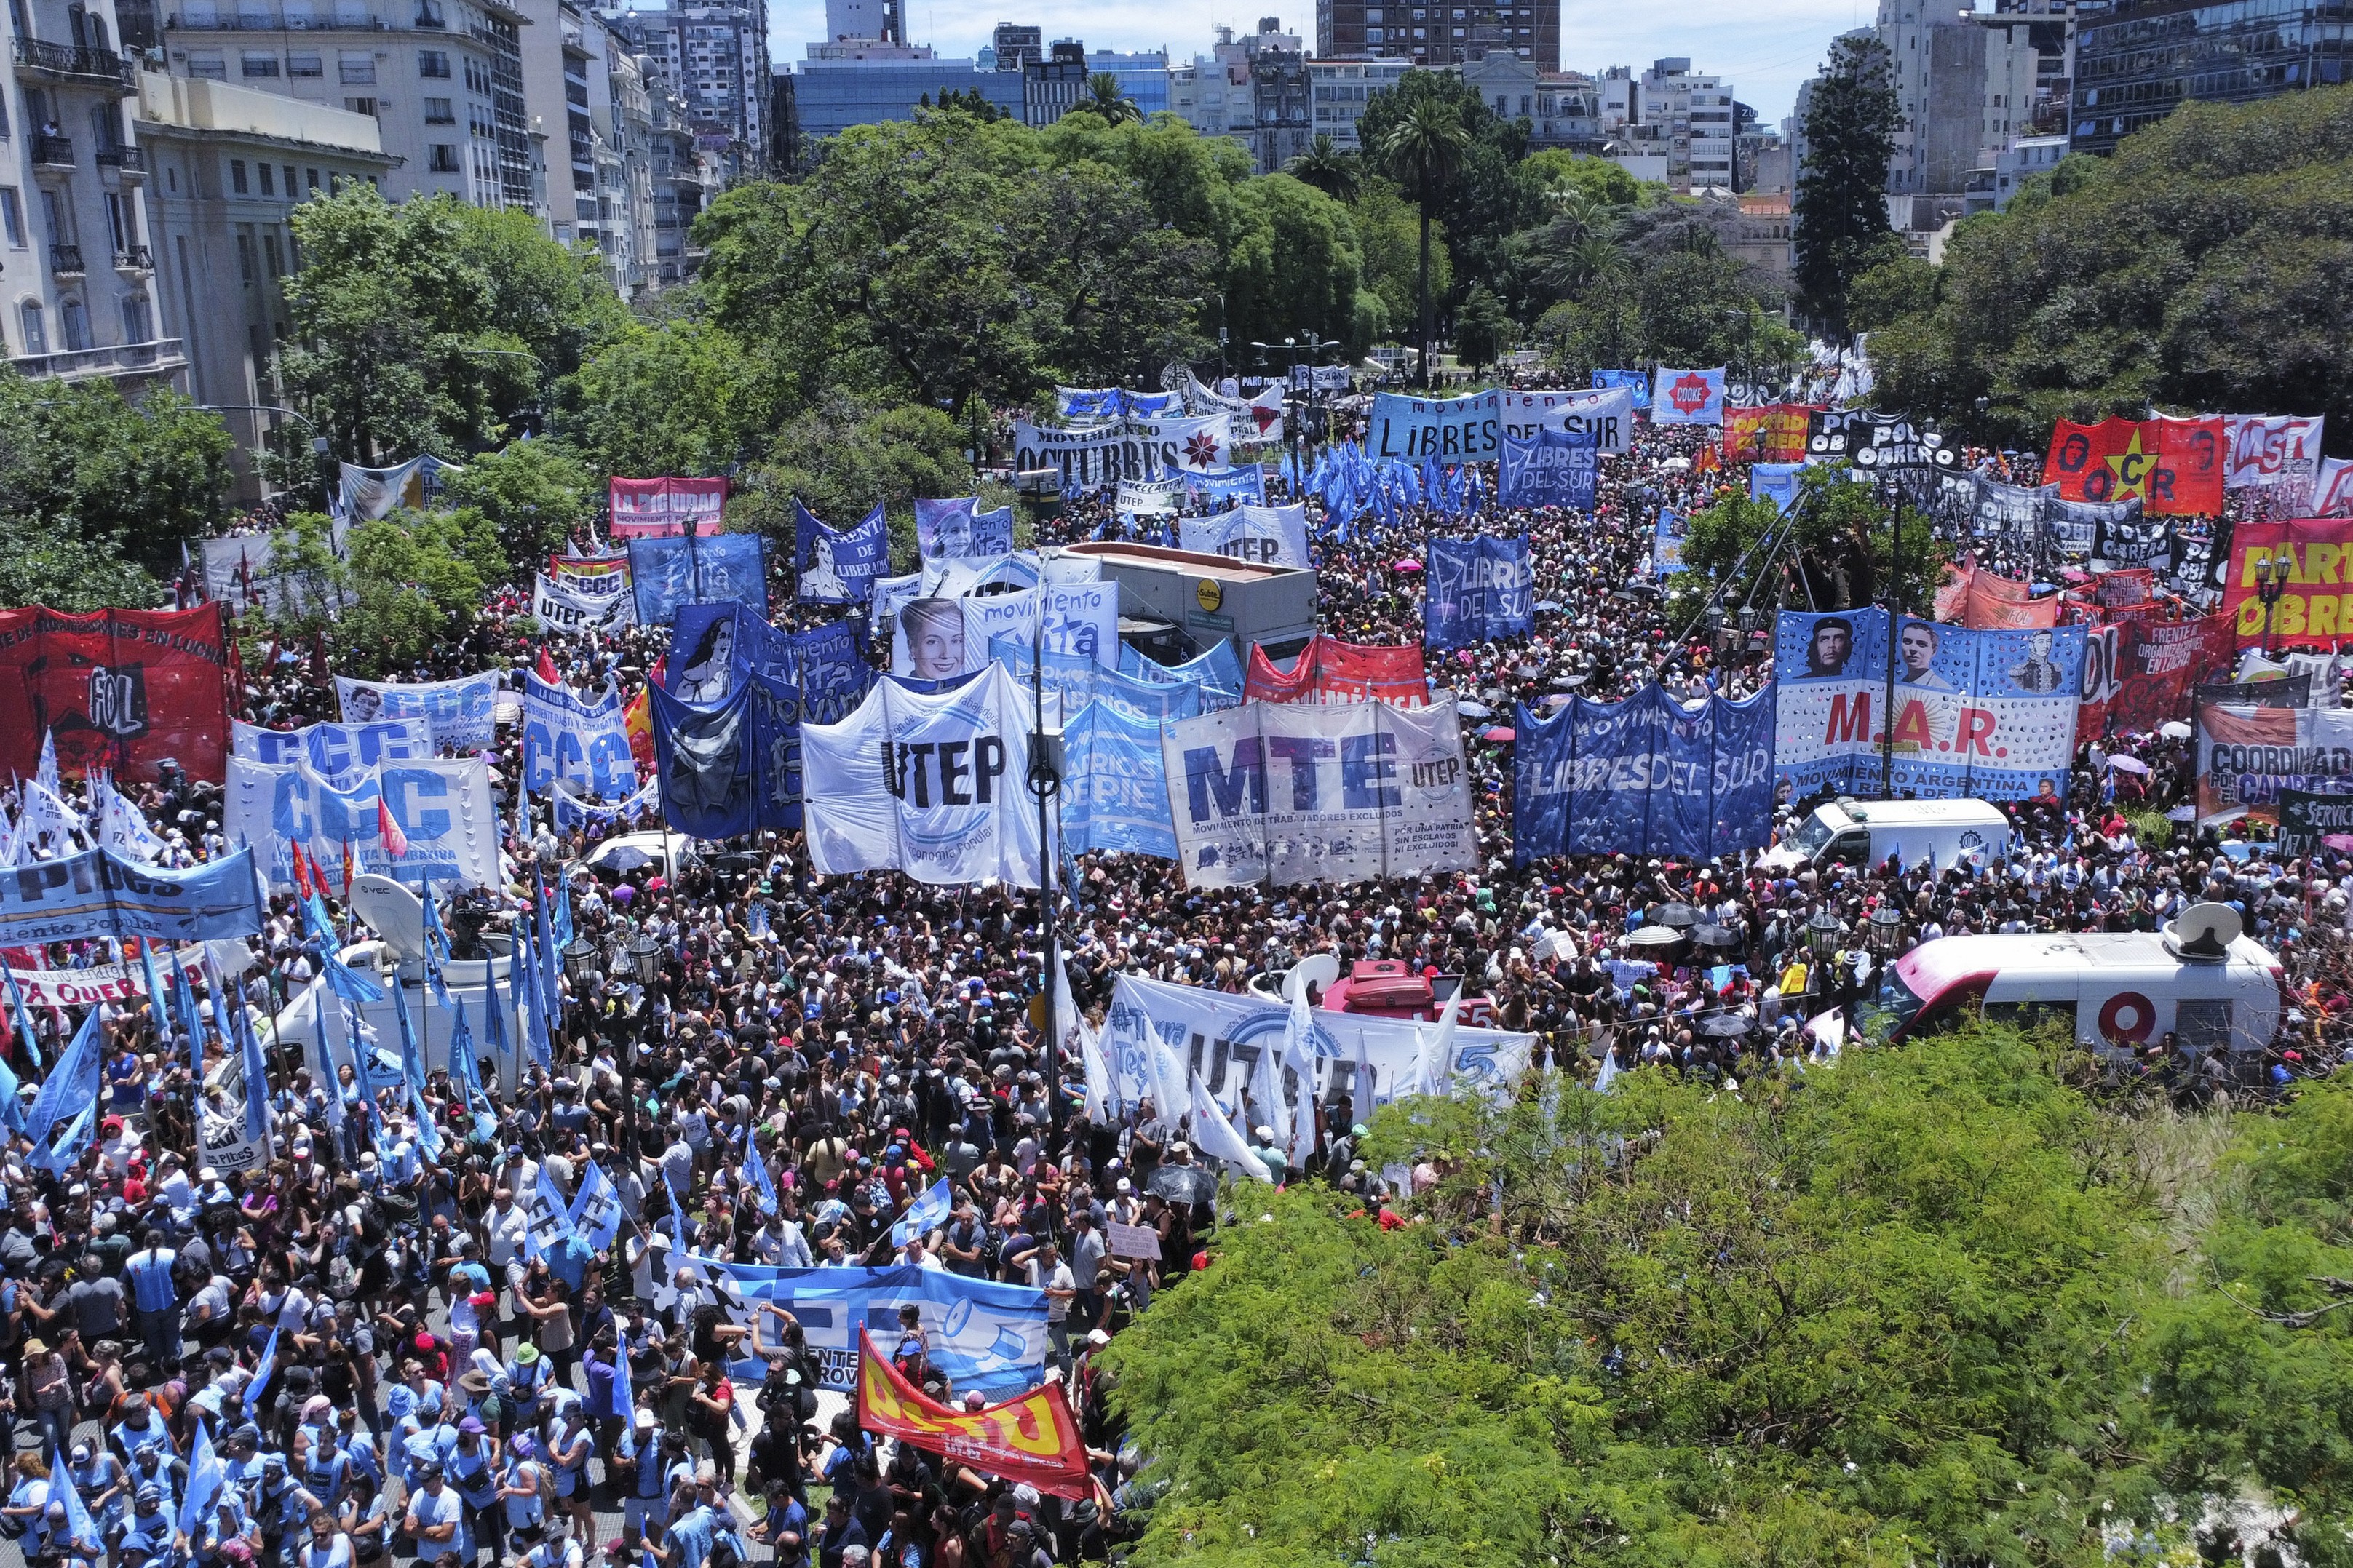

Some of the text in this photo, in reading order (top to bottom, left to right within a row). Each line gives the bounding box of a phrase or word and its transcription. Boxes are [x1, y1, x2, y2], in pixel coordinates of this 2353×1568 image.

[1677, 387, 1703, 402] COOKE
[1017, 441, 1178, 486] OCTUBRES
[1525, 447, 1596, 469] LIBRES
[1522, 472, 1595, 491] DEL SUR
[614, 492, 721, 512] LA DIGNIDAD
[1120, 495, 1143, 507] UTEP
[857, 545, 876, 558] DE
[1199, 589, 1218, 597] Subte
[541, 597, 586, 626] UTEP
[1460, 593, 1494, 621] DEL
[144, 629, 171, 647] EN
[2152, 626, 2191, 644] FRENTE
[2146, 655, 2191, 675] EN LUCHA
[89, 665, 143, 734] FOL
[1824, 691, 2009, 759] M.A.R.
[257, 722, 413, 776] CCC
[881, 735, 1007, 808] UTEP
[1183, 733, 1402, 823] MTE
[1413, 757, 1460, 789] UTEP
[1531, 749, 1769, 797] LIBRES DEL SUR
[1913, 773, 2028, 792] ARGENTINA
[273, 768, 451, 844] CCC
[1193, 809, 1403, 835] MOVIMIENTO DE TRABAJADORES EXCLUIDOS
[1415, 824, 1433, 833] UNA
[958, 824, 994, 856] Popular
[1394, 832, 1456, 845] SIN ESCLAVOS
[1394, 845, 1404, 854] NI
[2280, 827, 2301, 858] PAZ
[83, 915, 163, 933] Popular
